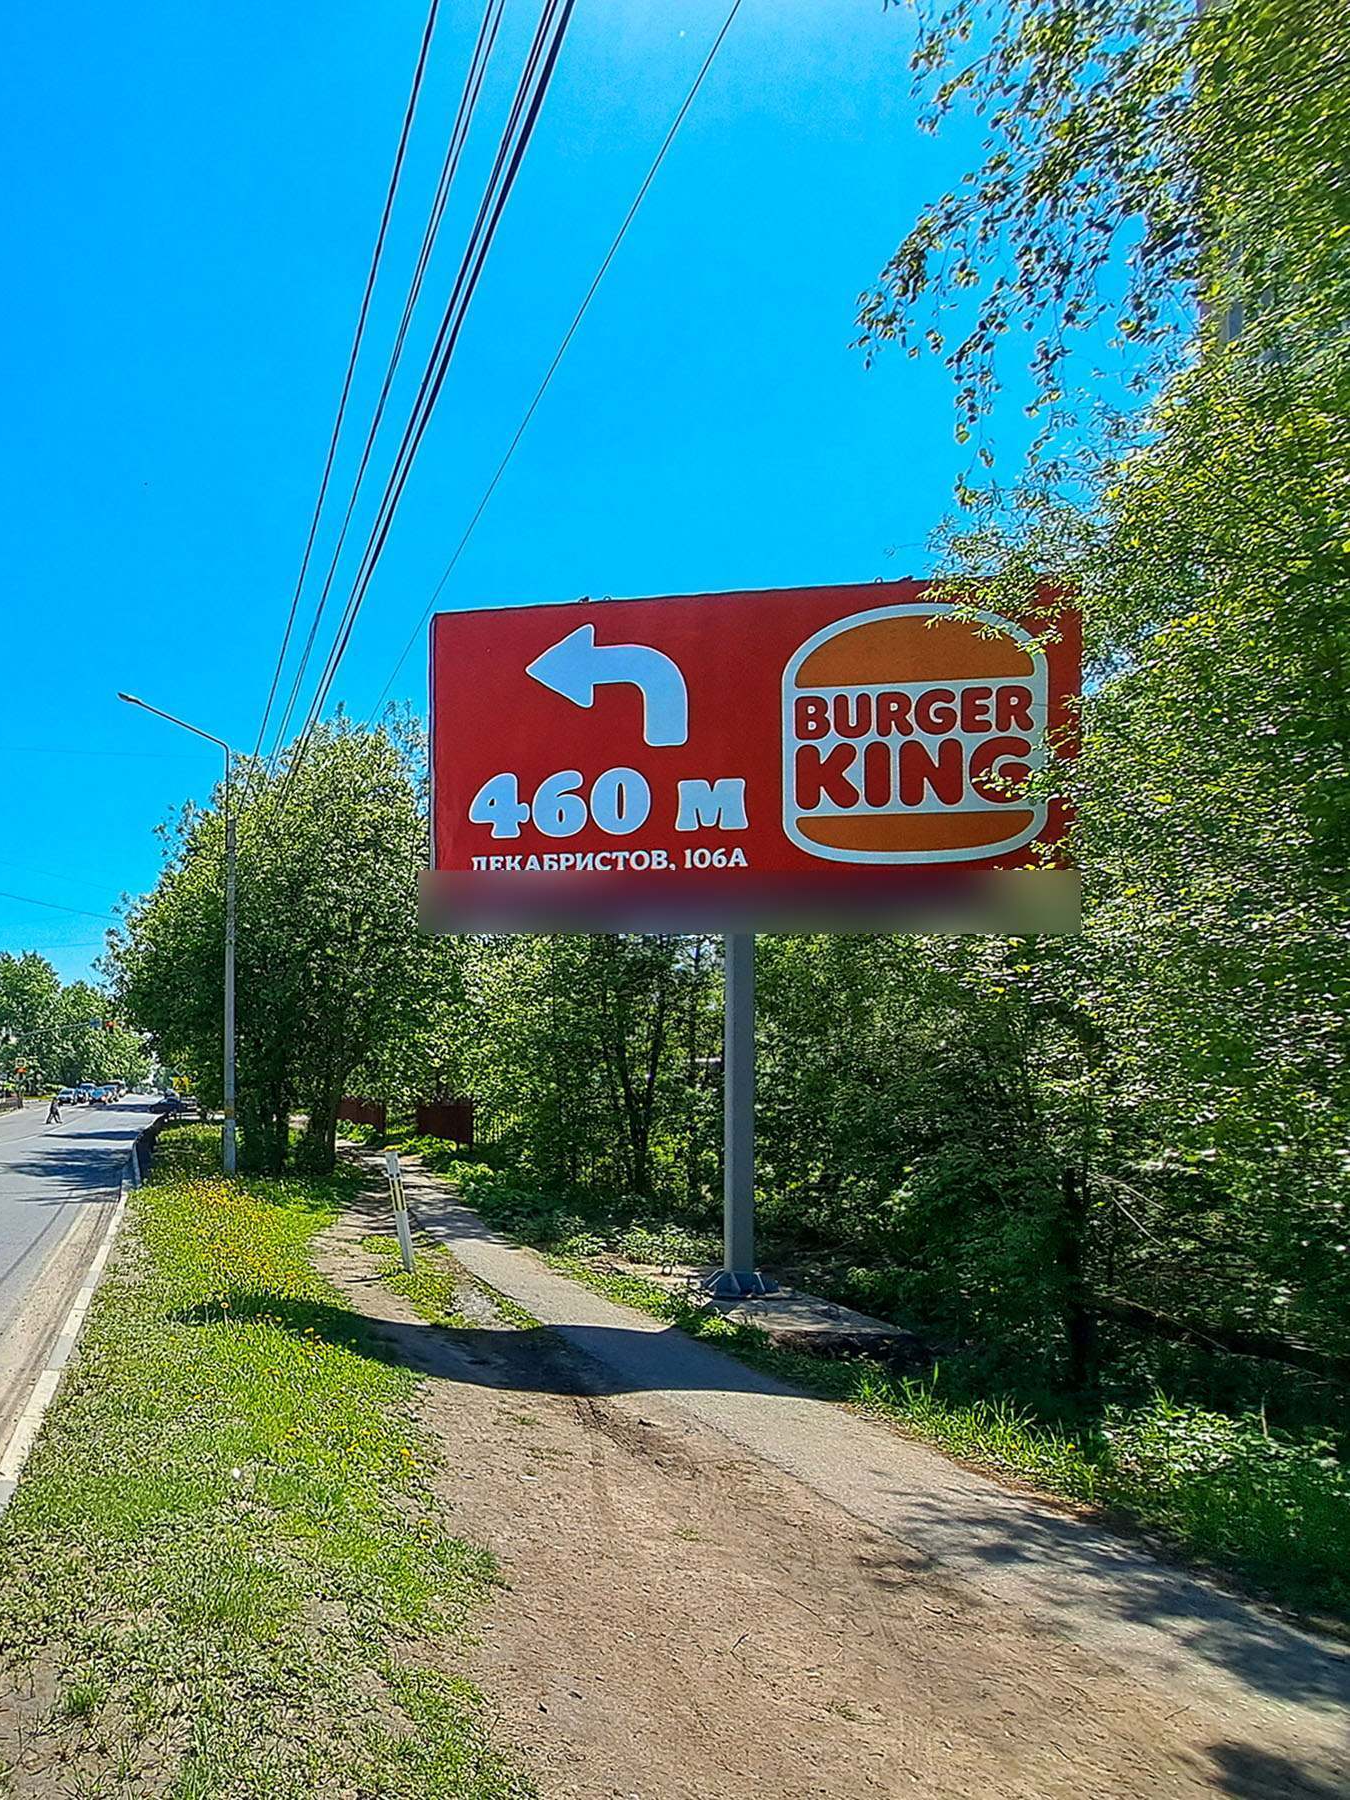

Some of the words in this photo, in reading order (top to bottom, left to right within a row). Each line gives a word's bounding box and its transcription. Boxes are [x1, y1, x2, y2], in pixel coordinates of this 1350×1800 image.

[794, 685, 1035, 740] BURGER
[469, 767, 651, 838] 460
[795, 736, 1034, 810] KING
